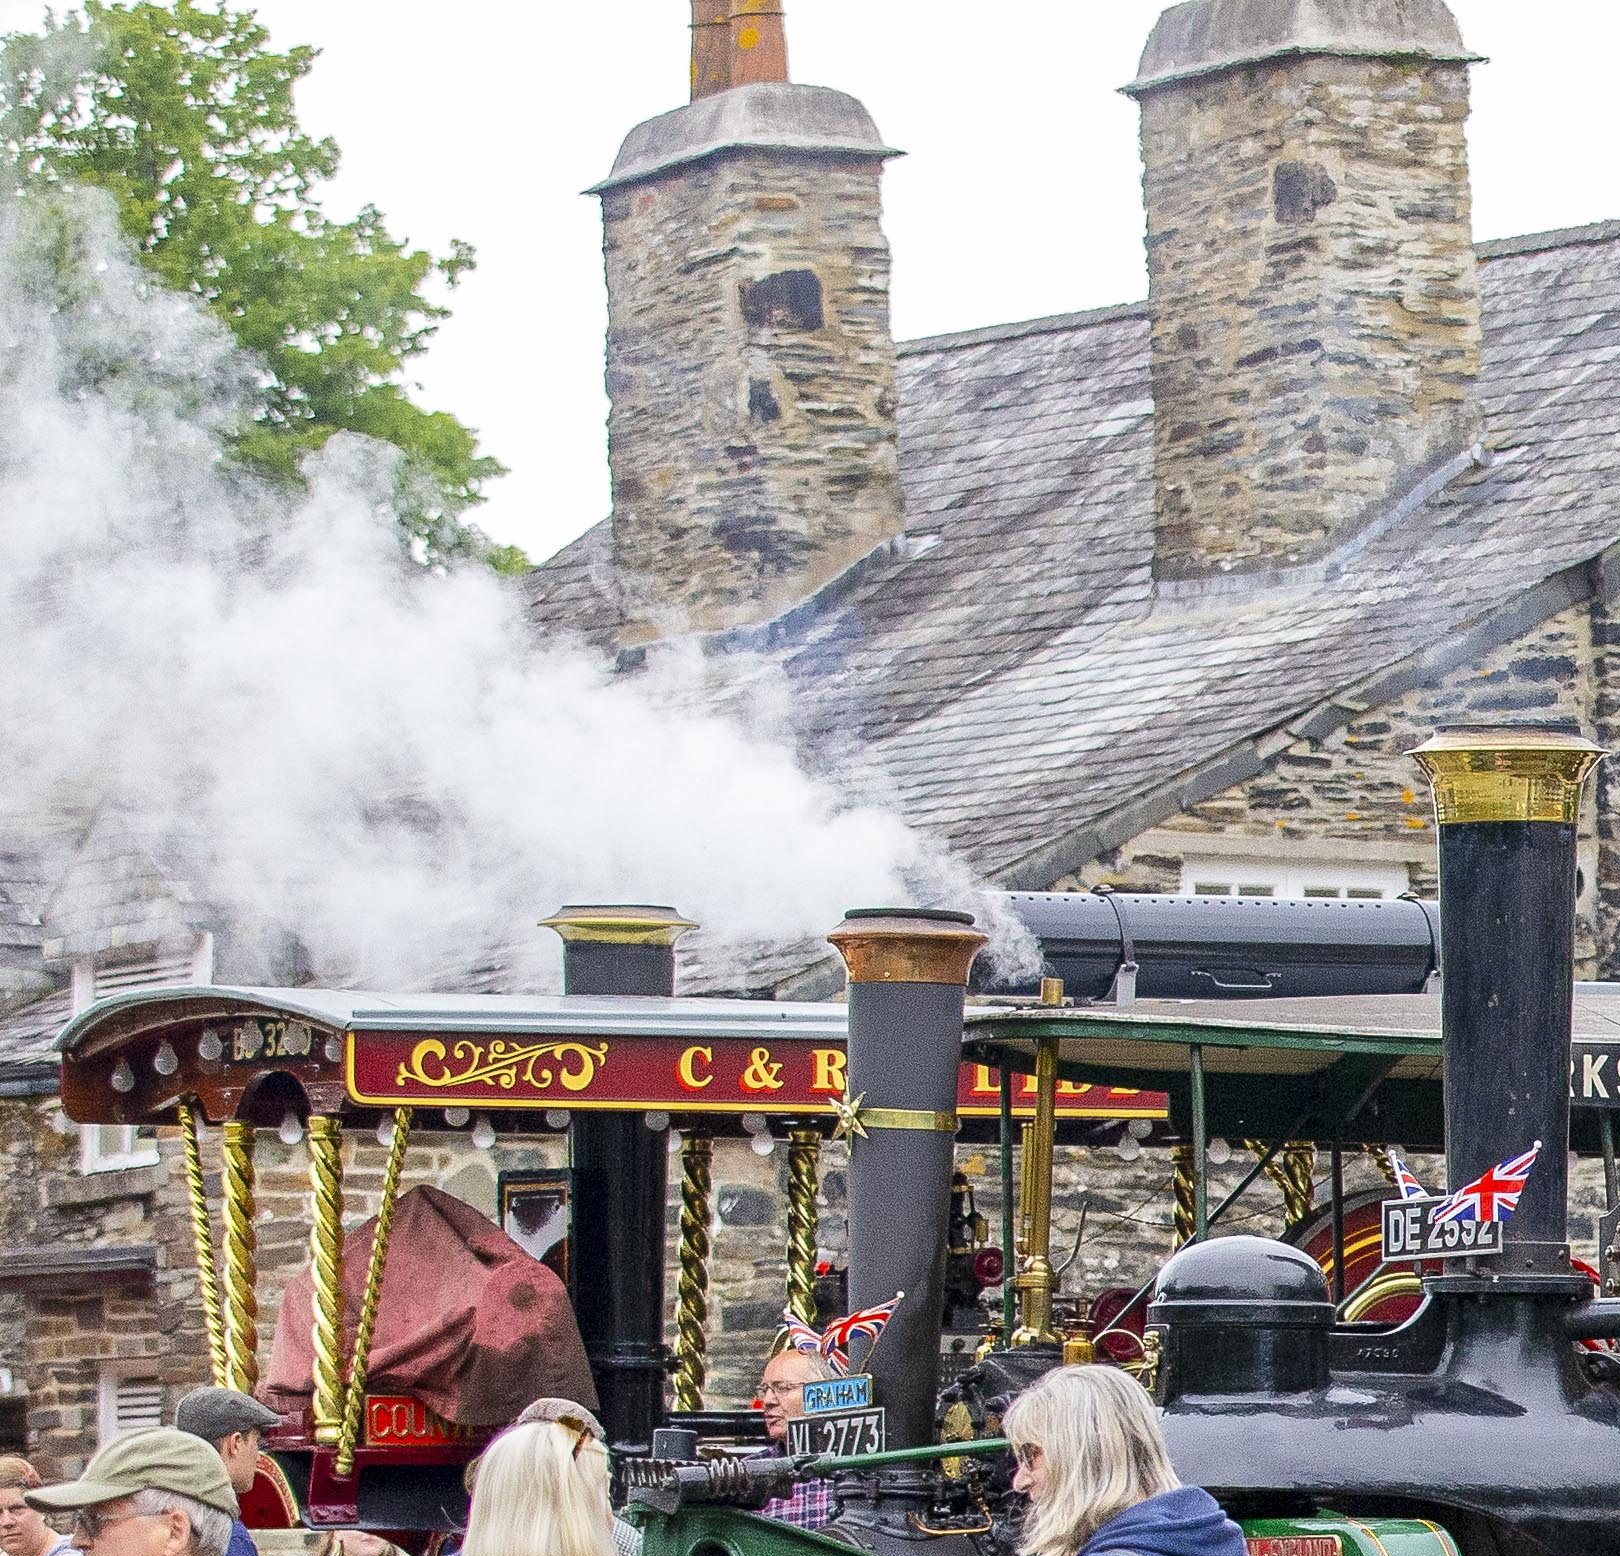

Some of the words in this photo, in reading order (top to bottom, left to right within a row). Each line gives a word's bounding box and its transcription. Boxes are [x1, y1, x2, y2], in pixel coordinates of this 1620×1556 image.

[675, 1045, 714, 1092] C
[738, 1046, 785, 1094] &
[1388, 1206, 1421, 1253] DE
[806, 1381, 868, 1409] GRAHAM
[823, 1414, 880, 1458] 2773
